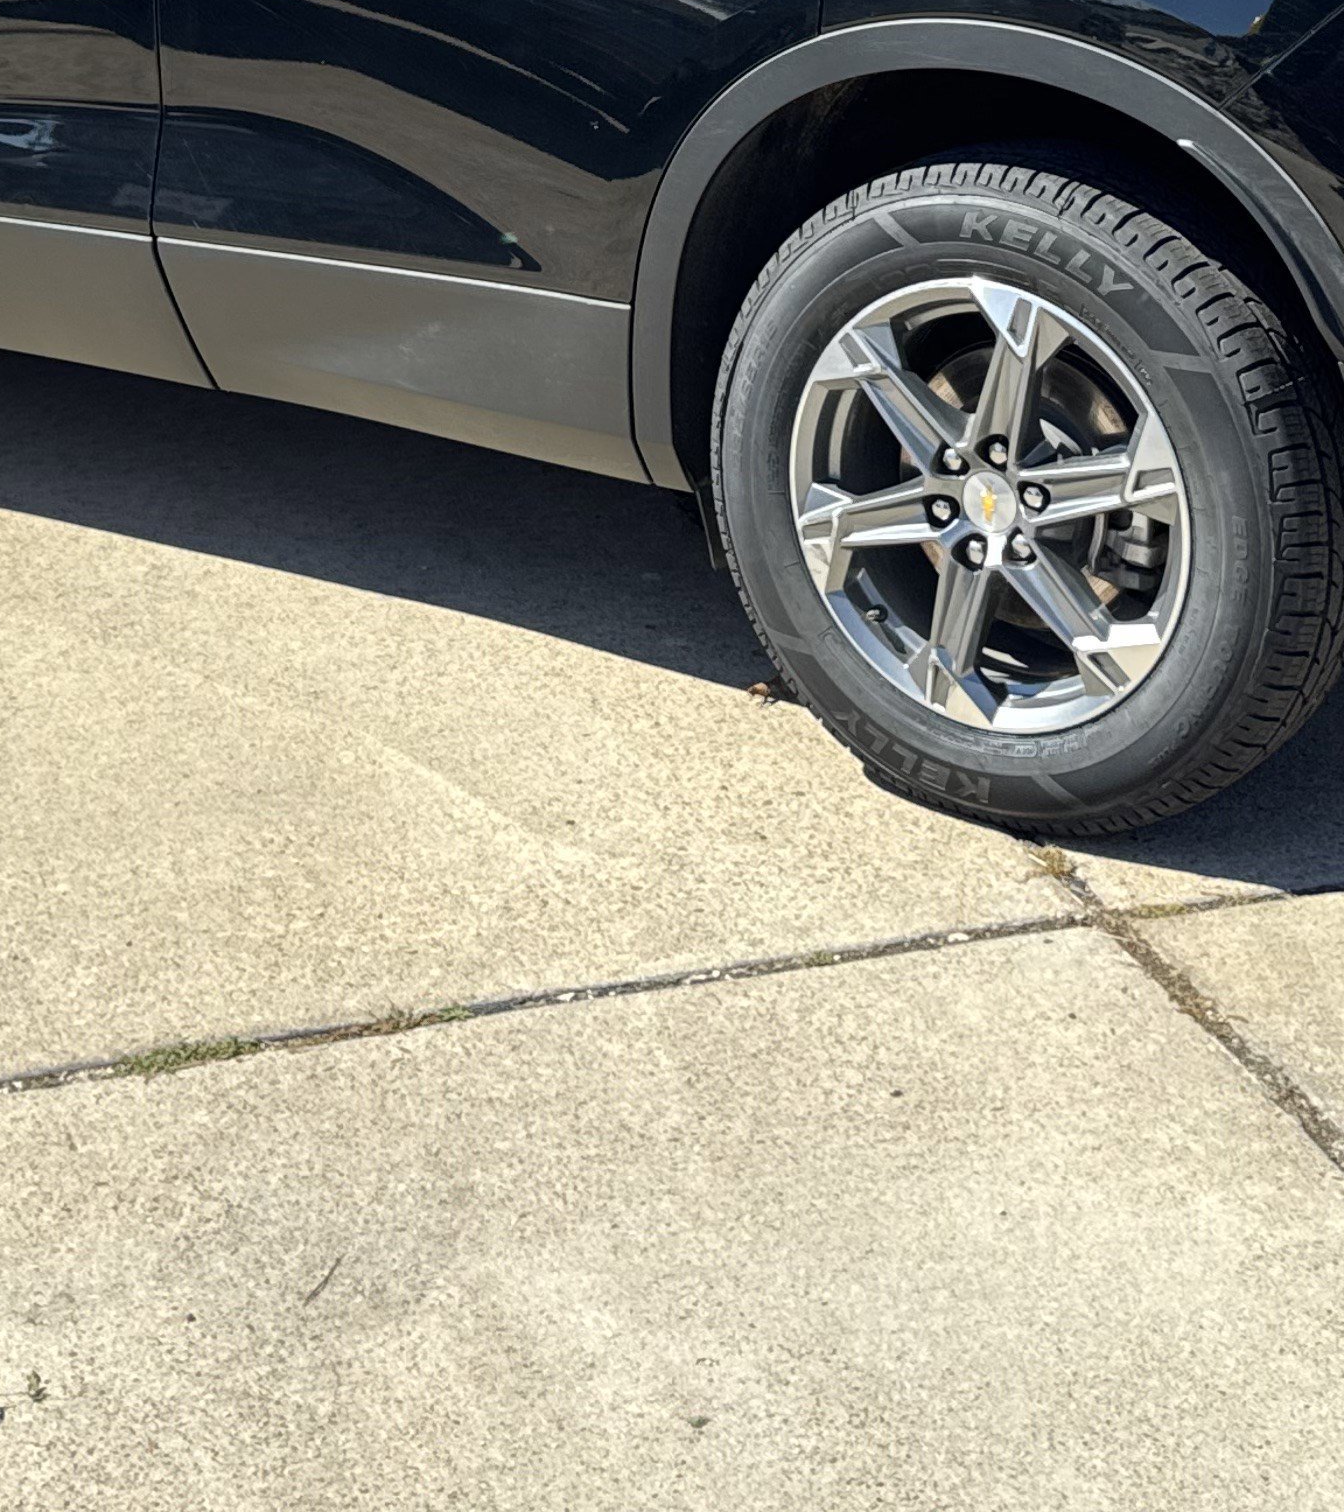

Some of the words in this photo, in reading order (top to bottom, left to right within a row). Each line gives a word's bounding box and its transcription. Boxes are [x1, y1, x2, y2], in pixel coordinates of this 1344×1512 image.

[958, 210, 1135, 296] KELLY
[1230, 514, 1249, 603] EDGE
[833, 709, 992, 805] KELLY
